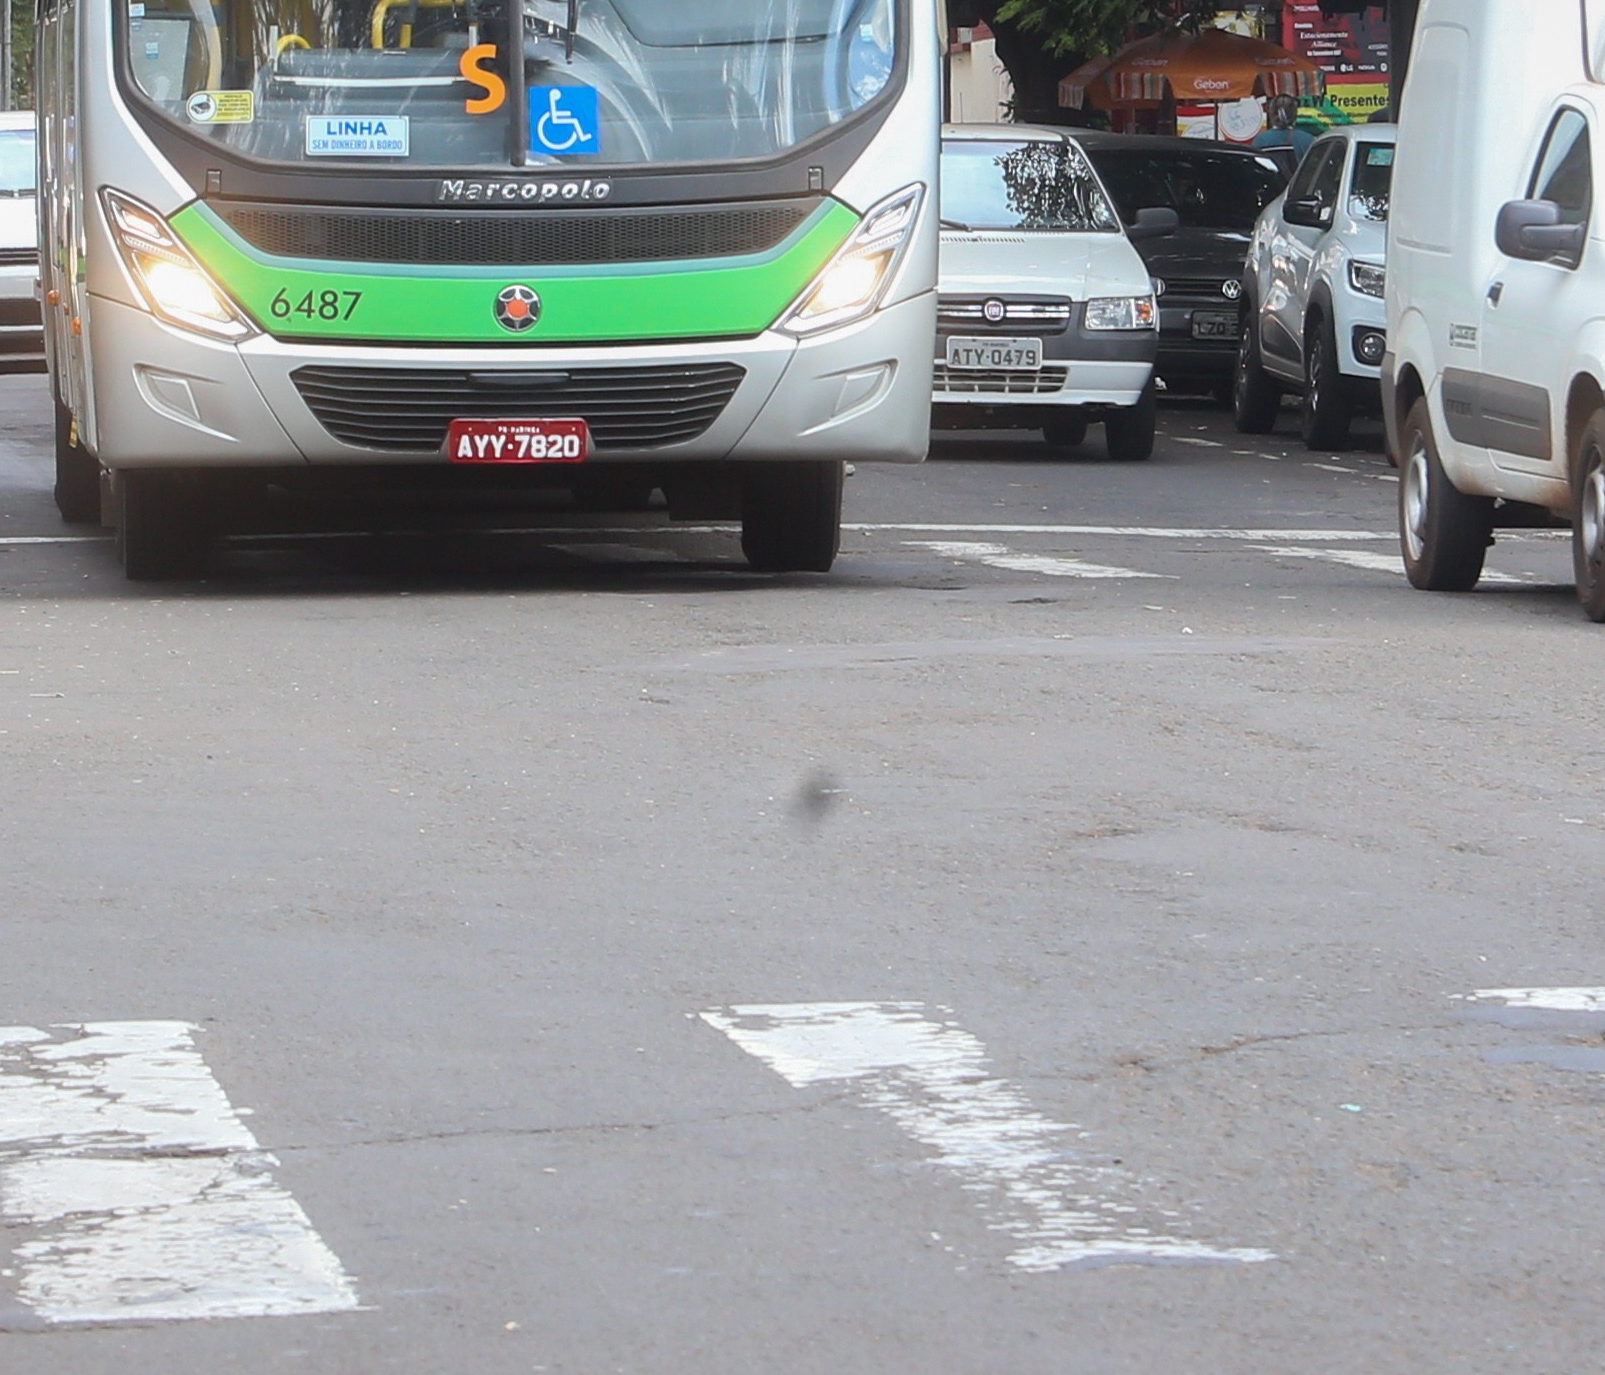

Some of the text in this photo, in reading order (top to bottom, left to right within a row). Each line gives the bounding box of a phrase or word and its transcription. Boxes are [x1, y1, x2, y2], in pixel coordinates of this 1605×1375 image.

[459, 43, 507, 115] S
[326, 121, 388, 136] LINHA
[312, 139, 403, 150] SEM DINHEIRO A BORDO
[438, 179, 611, 203] Marcopolo
[270, 287, 363, 322] 6487
